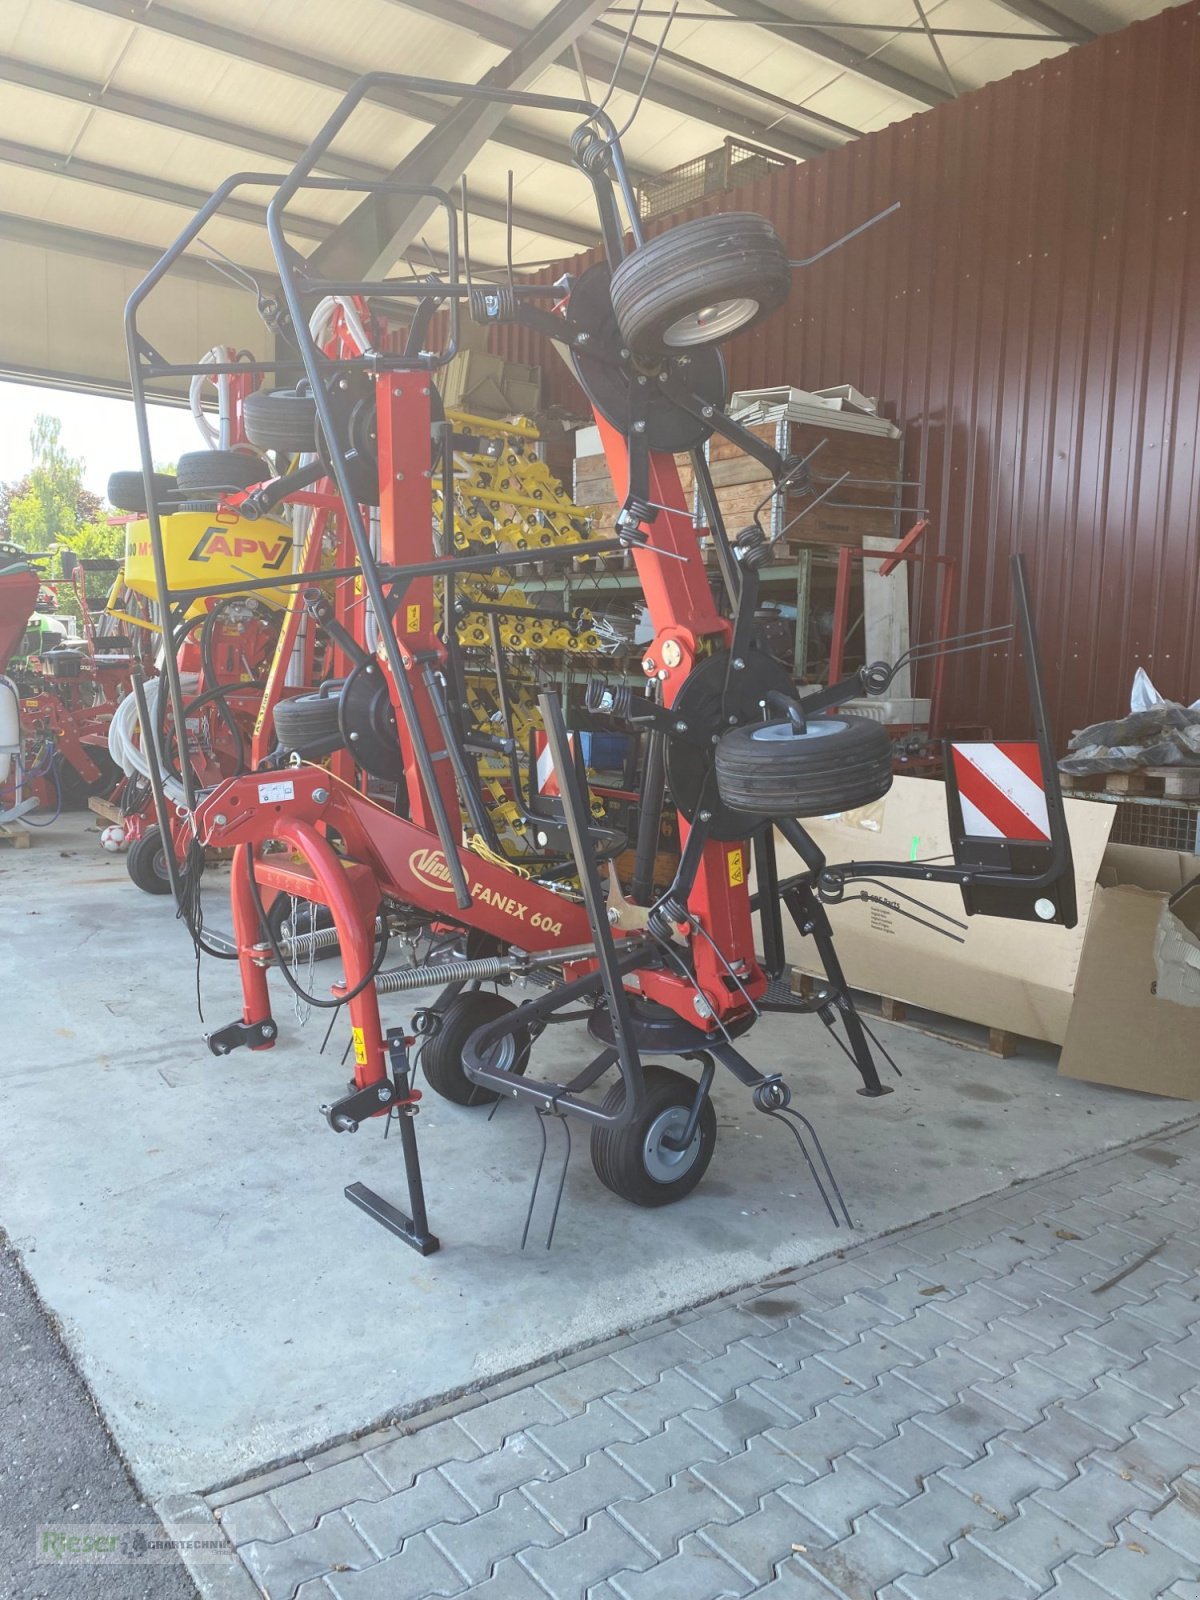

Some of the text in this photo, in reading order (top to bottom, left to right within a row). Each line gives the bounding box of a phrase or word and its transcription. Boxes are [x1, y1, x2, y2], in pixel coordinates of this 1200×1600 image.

[205, 535, 282, 561] APV
[470, 882, 528, 921] FANEX
[530, 912, 563, 937] 604
